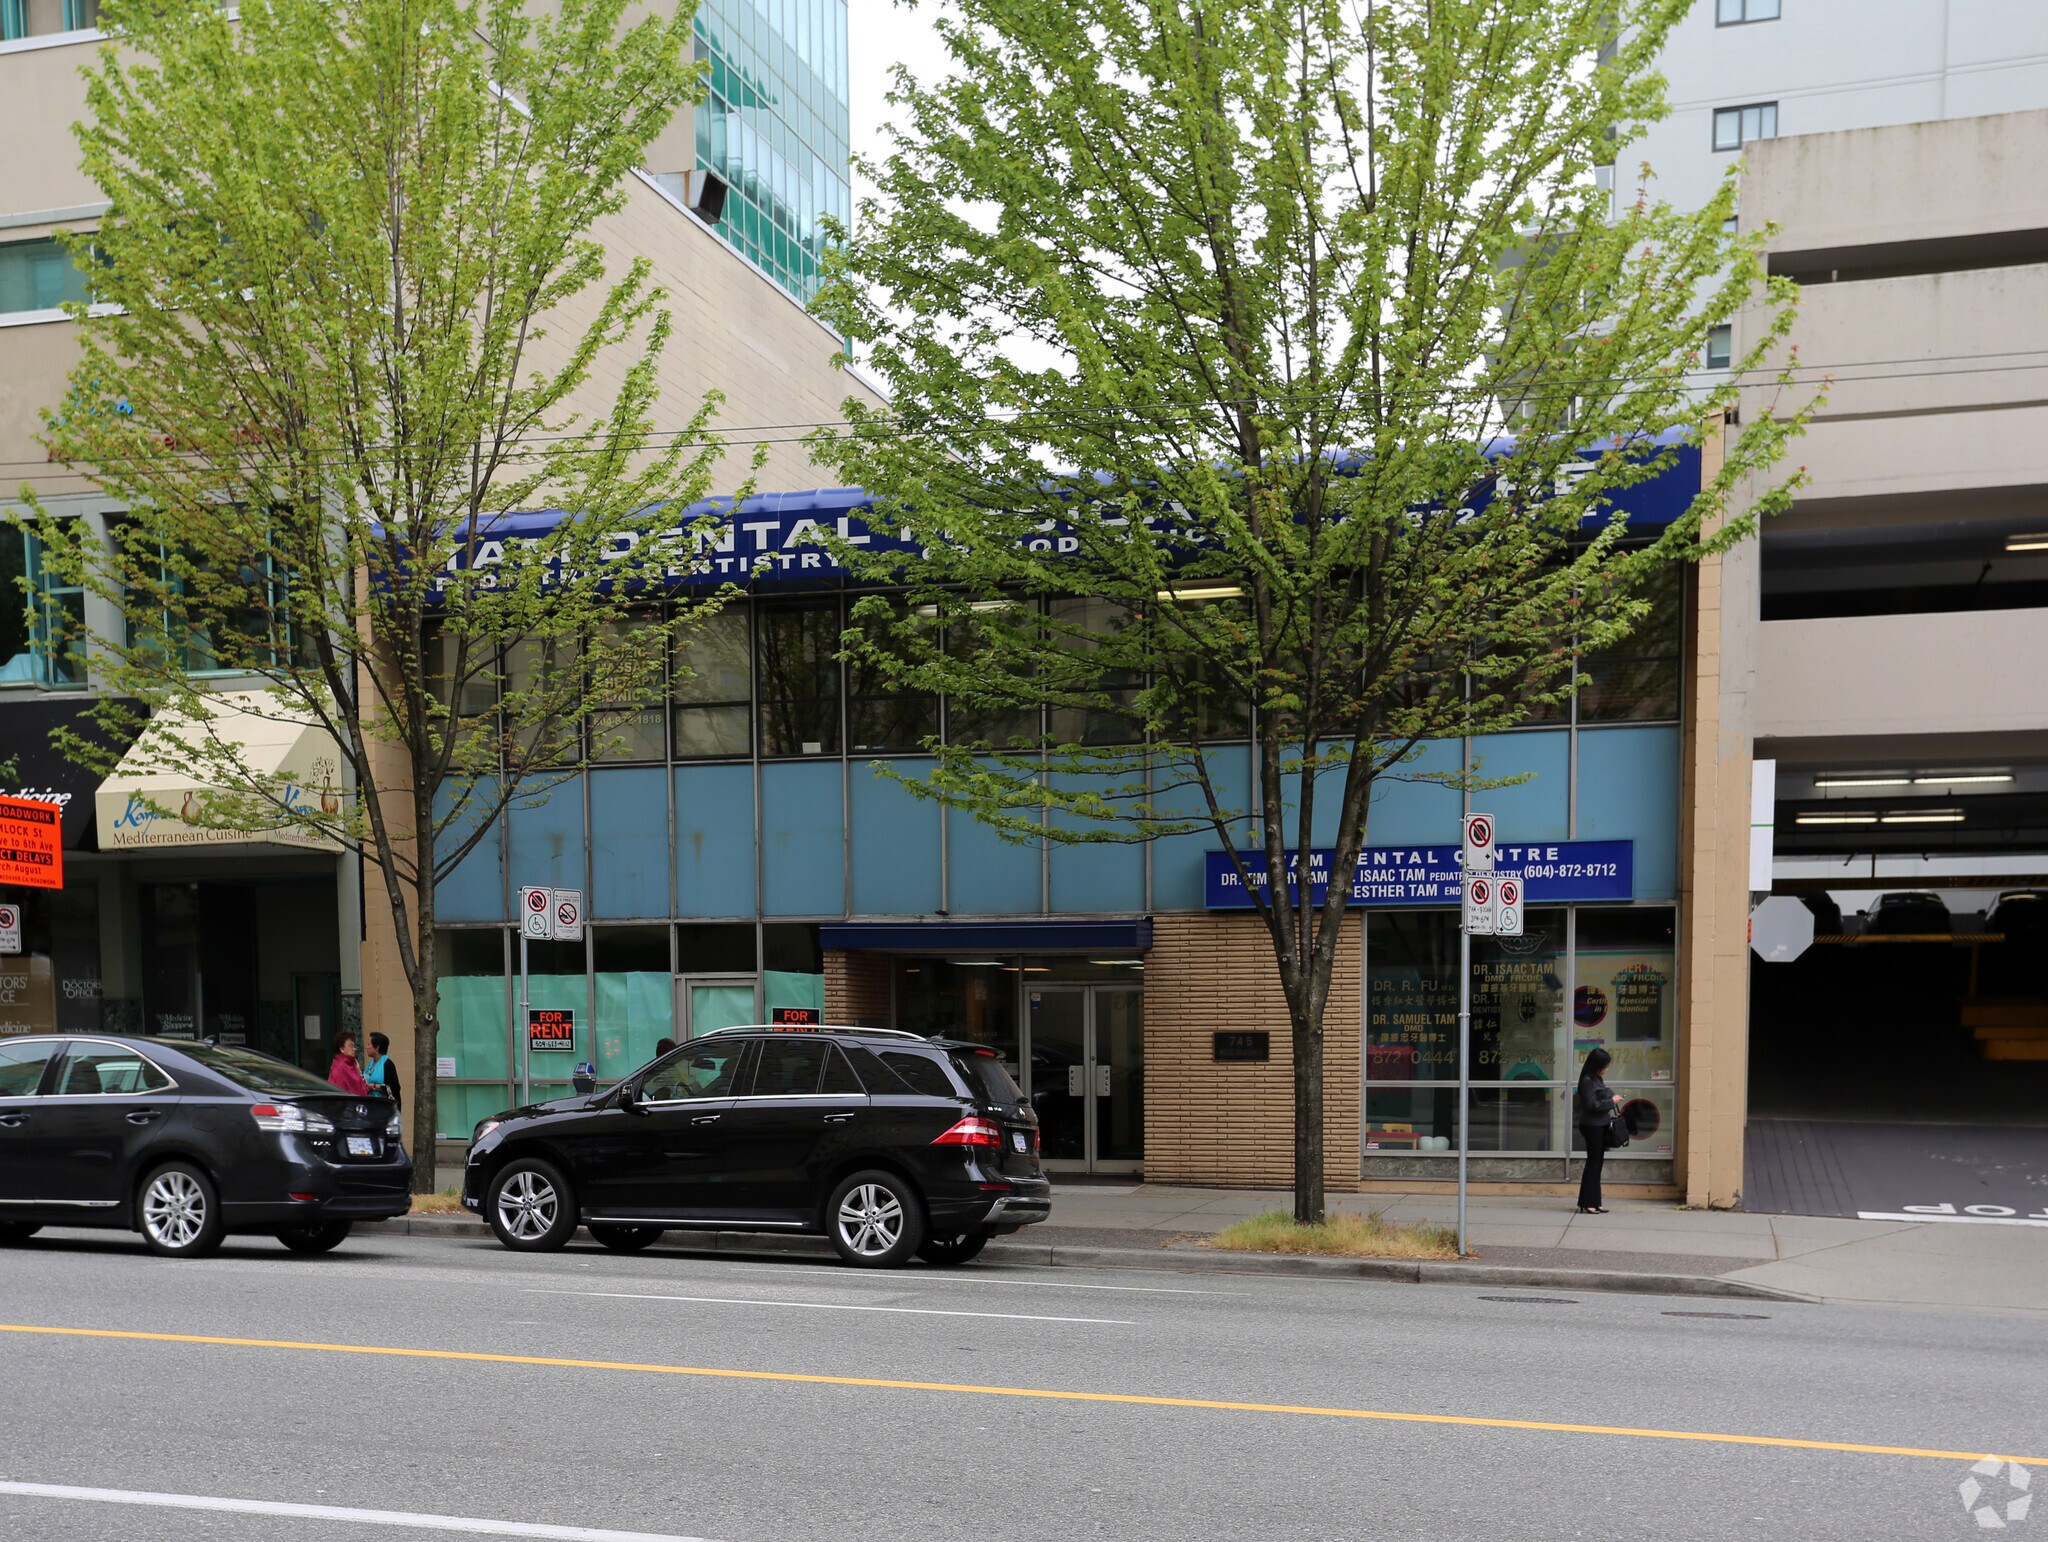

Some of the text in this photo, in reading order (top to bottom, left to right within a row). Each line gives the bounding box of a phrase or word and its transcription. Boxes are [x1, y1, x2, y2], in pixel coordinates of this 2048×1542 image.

[600, 517, 871, 560] DENTAL
[0, 787, 72, 806] dicine
[33, 828, 42, 838] St
[113, 829, 252, 844] Mediterranean Cuisine
[12, 838, 19, 847] to
[24, 840, 36, 849] 6th
[40, 842, 53, 851] Ave
[17, 851, 51, 864] DELAYS
[1284, 847, 1559, 867] AM ENTAL CNTRE
[1221, 873, 1242, 885] DR.
[1360, 869, 1396, 882] ISAAC
[1399, 867, 1425, 881] TAM
[1524, 863, 1616, 879] (604)-872-8712
[1354, 885, 1404, 898] ESTHER
[1409, 884, 1437, 897] TAM
[1473, 963, 1553, 975] DR. ISAAC TAM
[1374, 980, 1395, 991] DR.
[1402, 980, 1414, 991] R.
[1421, 980, 1437, 991] FU
[1473, 994, 1490, 1004] DR.
[1620, 997, 1657, 1006] Specialist
[540, 1011, 562, 1022] FOR
[783, 1010, 808, 1021] FOR
[1373, 1014, 1456, 1025] DR. SAMUEL TAM
[530, 1023, 572, 1038] RENT
[1404, 1024, 1424, 1032] DMD
[1373, 1051, 1454, 1064] 872 0444
